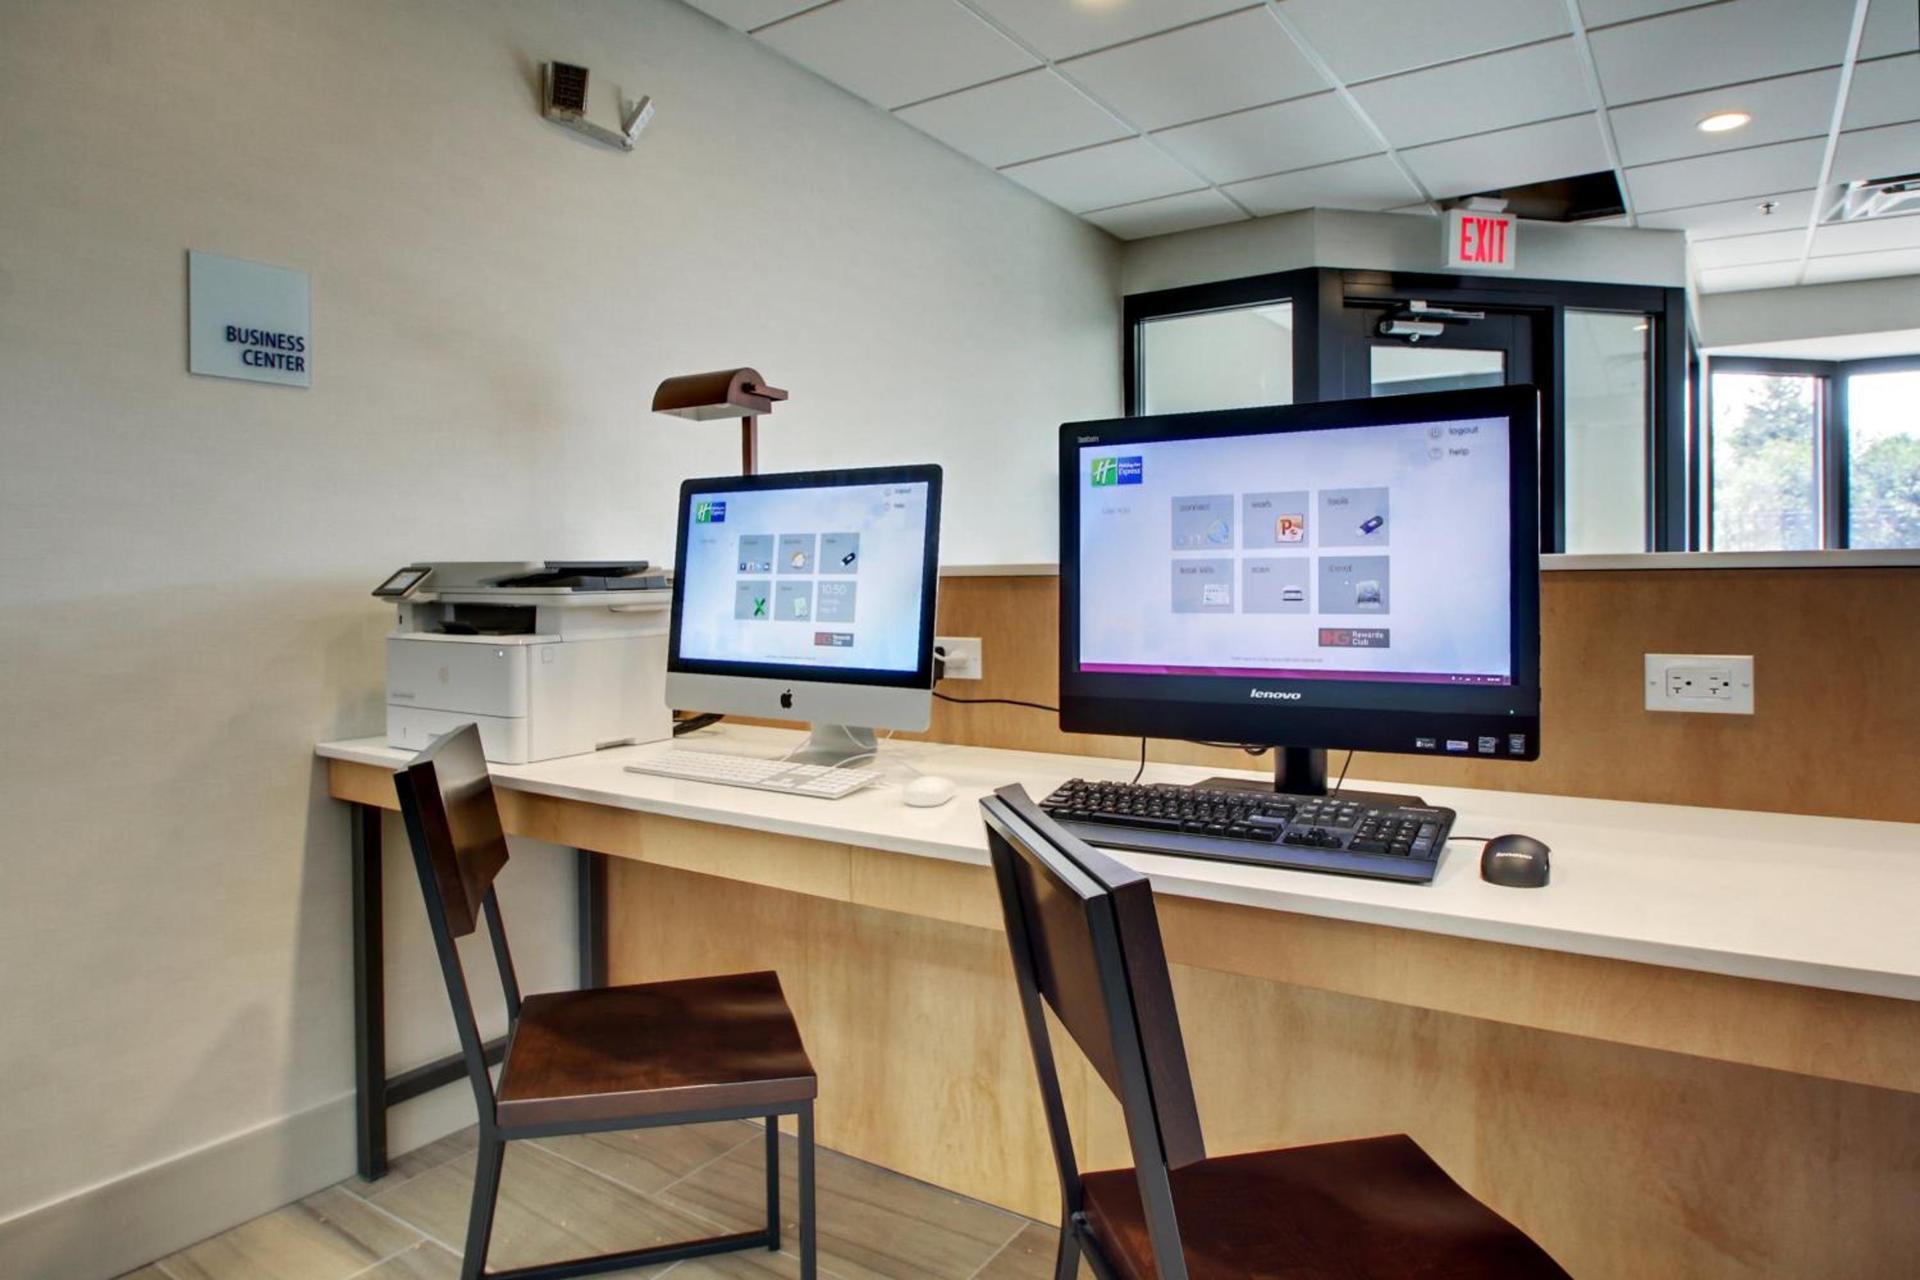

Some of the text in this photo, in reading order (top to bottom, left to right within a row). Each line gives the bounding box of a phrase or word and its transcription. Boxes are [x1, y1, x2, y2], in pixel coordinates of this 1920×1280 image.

[1460, 216, 1509, 264] EXIT
[225, 325, 305, 352] BUSINESS
[242, 349, 305, 372] CENTER
[1352, 638, 1369, 646] Club
[1250, 688, 1301, 701] lenovo
